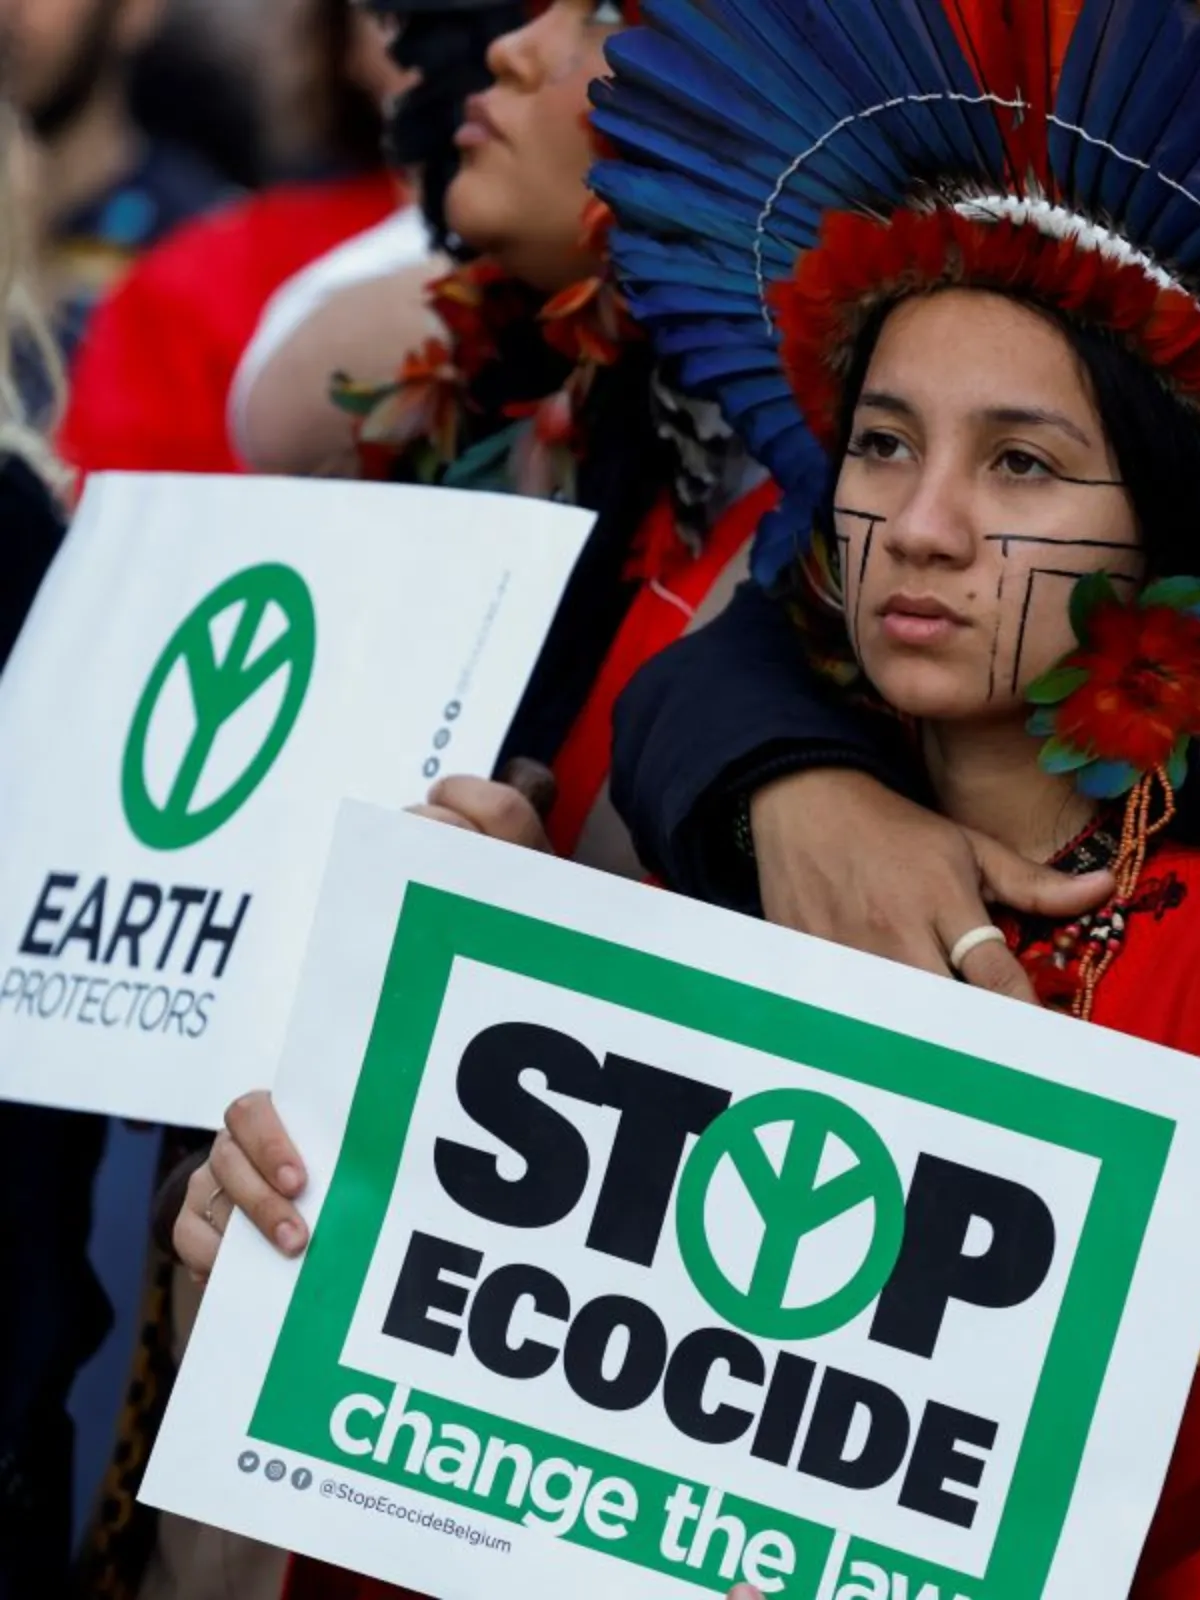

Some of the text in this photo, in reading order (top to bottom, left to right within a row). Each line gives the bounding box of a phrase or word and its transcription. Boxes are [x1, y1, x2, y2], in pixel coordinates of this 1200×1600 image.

[0, 966, 216, 1039] PROTECTORS
[17, 869, 253, 980] EARTH
[434, 1021, 1056, 1359] STOP
[381, 1230, 999, 1529] ECOCIDE
[319, 1478, 512, 1553] @StopEcocideBelgium
[328, 1382, 639, 1538] change
[660, 1484, 796, 1593] the
